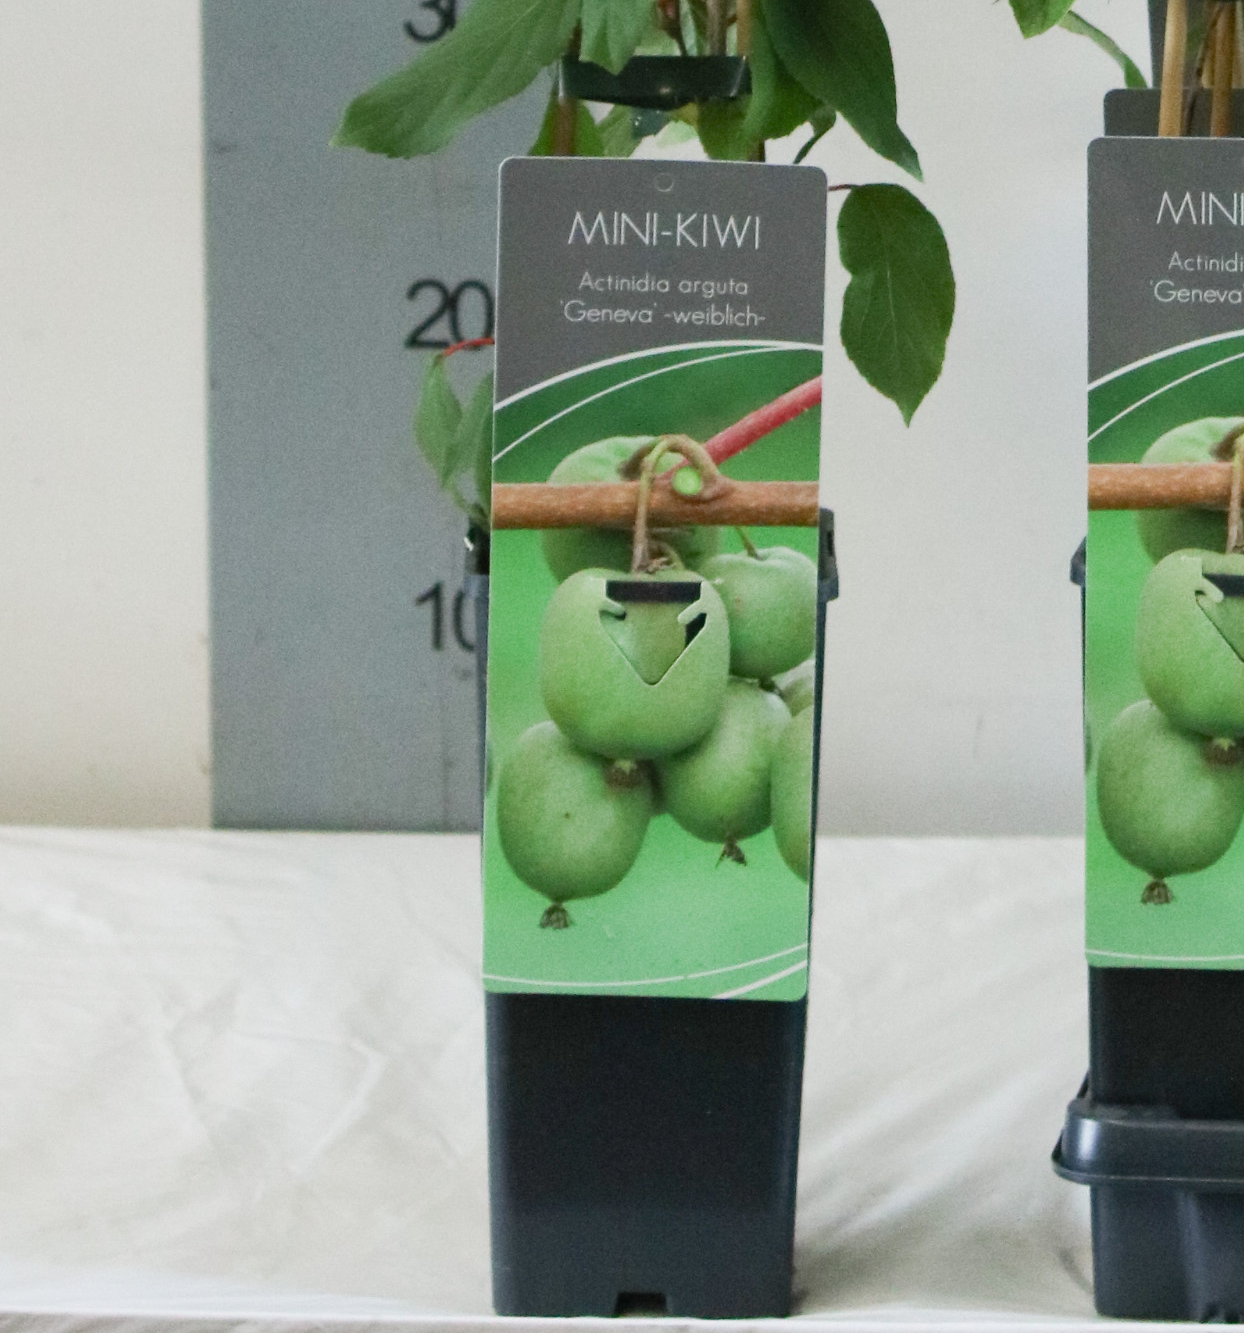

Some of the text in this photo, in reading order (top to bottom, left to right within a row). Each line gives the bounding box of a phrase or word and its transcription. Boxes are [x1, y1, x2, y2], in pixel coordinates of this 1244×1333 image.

[568, 211, 760, 250] MINI-KIWI
[578, 271, 748, 298] Actinidia arguta
[405, 279, 494, 351] 20
[664, 303, 766, 327] -weiblich-
